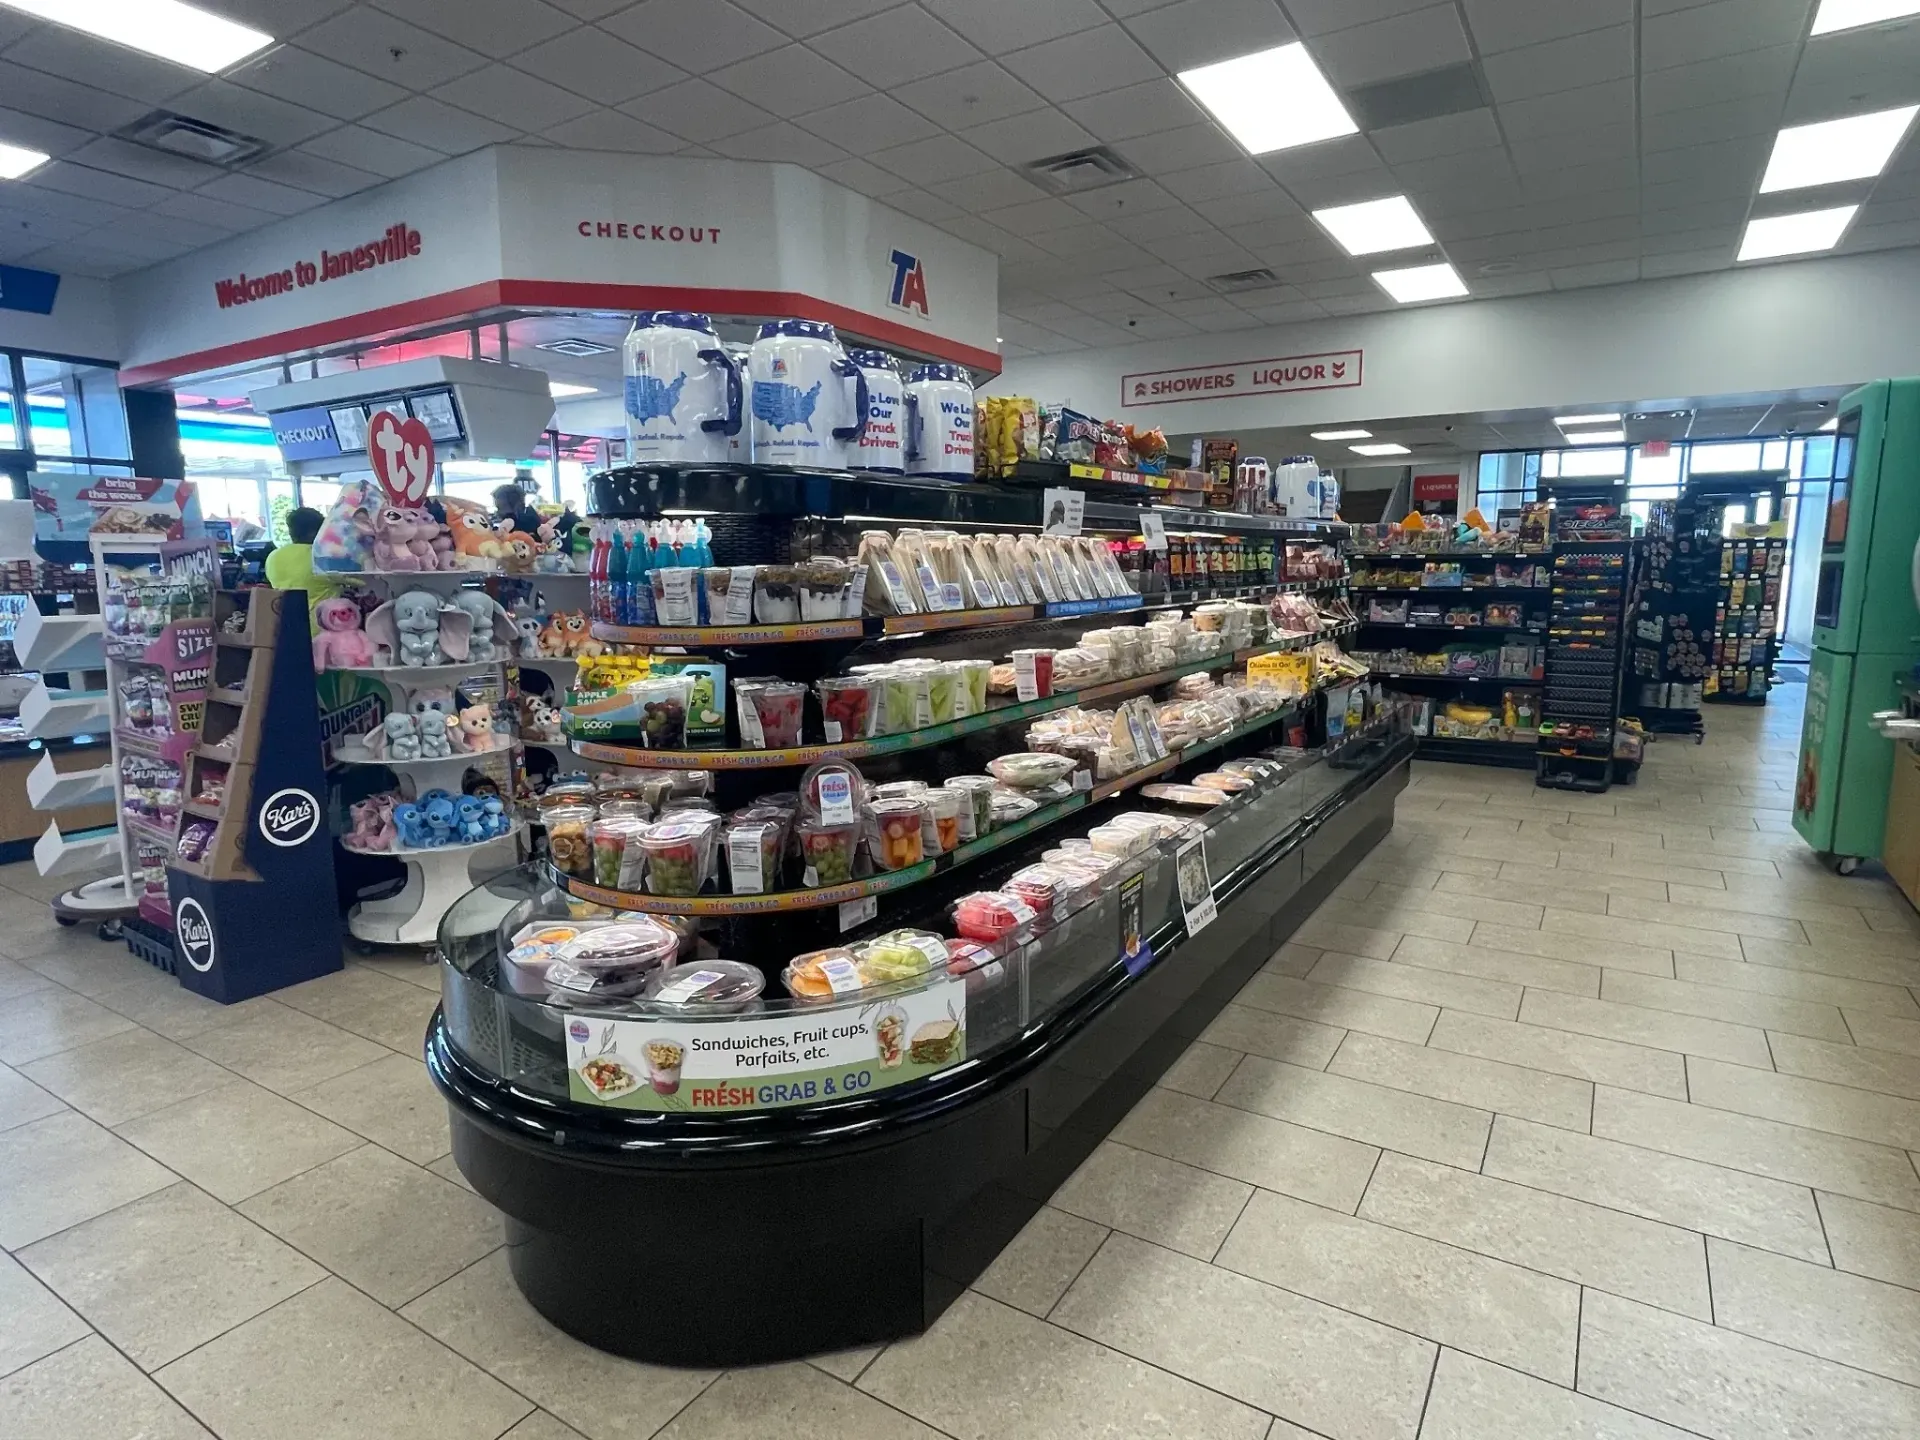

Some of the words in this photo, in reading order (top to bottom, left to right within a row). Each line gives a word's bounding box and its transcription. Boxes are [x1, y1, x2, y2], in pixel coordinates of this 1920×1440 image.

[577, 220, 722, 245] CHECKOUT
[215, 270, 294, 309] Welcome
[294, 260, 317, 288] to
[319, 222, 422, 283] Janesville
[891, 248, 930, 316] TA
[1150, 373, 1235, 396] SHOWERS
[1252, 364, 1326, 386] LIQUOR
[870, 407, 893, 419] Our
[940, 402, 959, 413] We
[865, 421, 896, 434] Truck
[954, 416, 970, 428] Our
[275, 424, 331, 445] CHECKOUT
[859, 436, 899, 449] Drivers
[944, 444, 973, 456] Drive
[376, 418, 428, 502] ty
[105, 478, 136, 490] bring
[88, 490, 108, 499] the
[110, 492, 143, 500] wows
[169, 548, 214, 577] MUNCH
[176, 627, 211, 635] FAMILY
[772, 630, 784, 639] GO
[177, 636, 214, 658] SIZE
[577, 691, 608, 699] APPLE
[179, 703, 203, 713] SW
[320, 697, 376, 742] OUNTAIN
[582, 718, 613, 729] GOGO
[656, 755, 677, 765] GRAB
[738, 754, 763, 765] GRAB
[773, 754, 785, 763] GO
[821, 780, 848, 792] FRÉSH
[266, 799, 312, 830] Kar's
[732, 901, 756, 910] GRAB
[767, 899, 780, 908] GO
[181, 917, 209, 942] Kar's
[692, 1034, 790, 1051] Sandwiches,
[793, 1027, 829, 1045] Fruit
[832, 1023, 869, 1040] cups,
[736, 1049, 800, 1068] Parfaits,
[803, 1046, 830, 1061] etc.
[691, 1080, 755, 1107] FRÉSH
[758, 1080, 817, 1104] GRAB
[823, 1077, 837, 1095] &
[843, 1070, 872, 1092] GO
